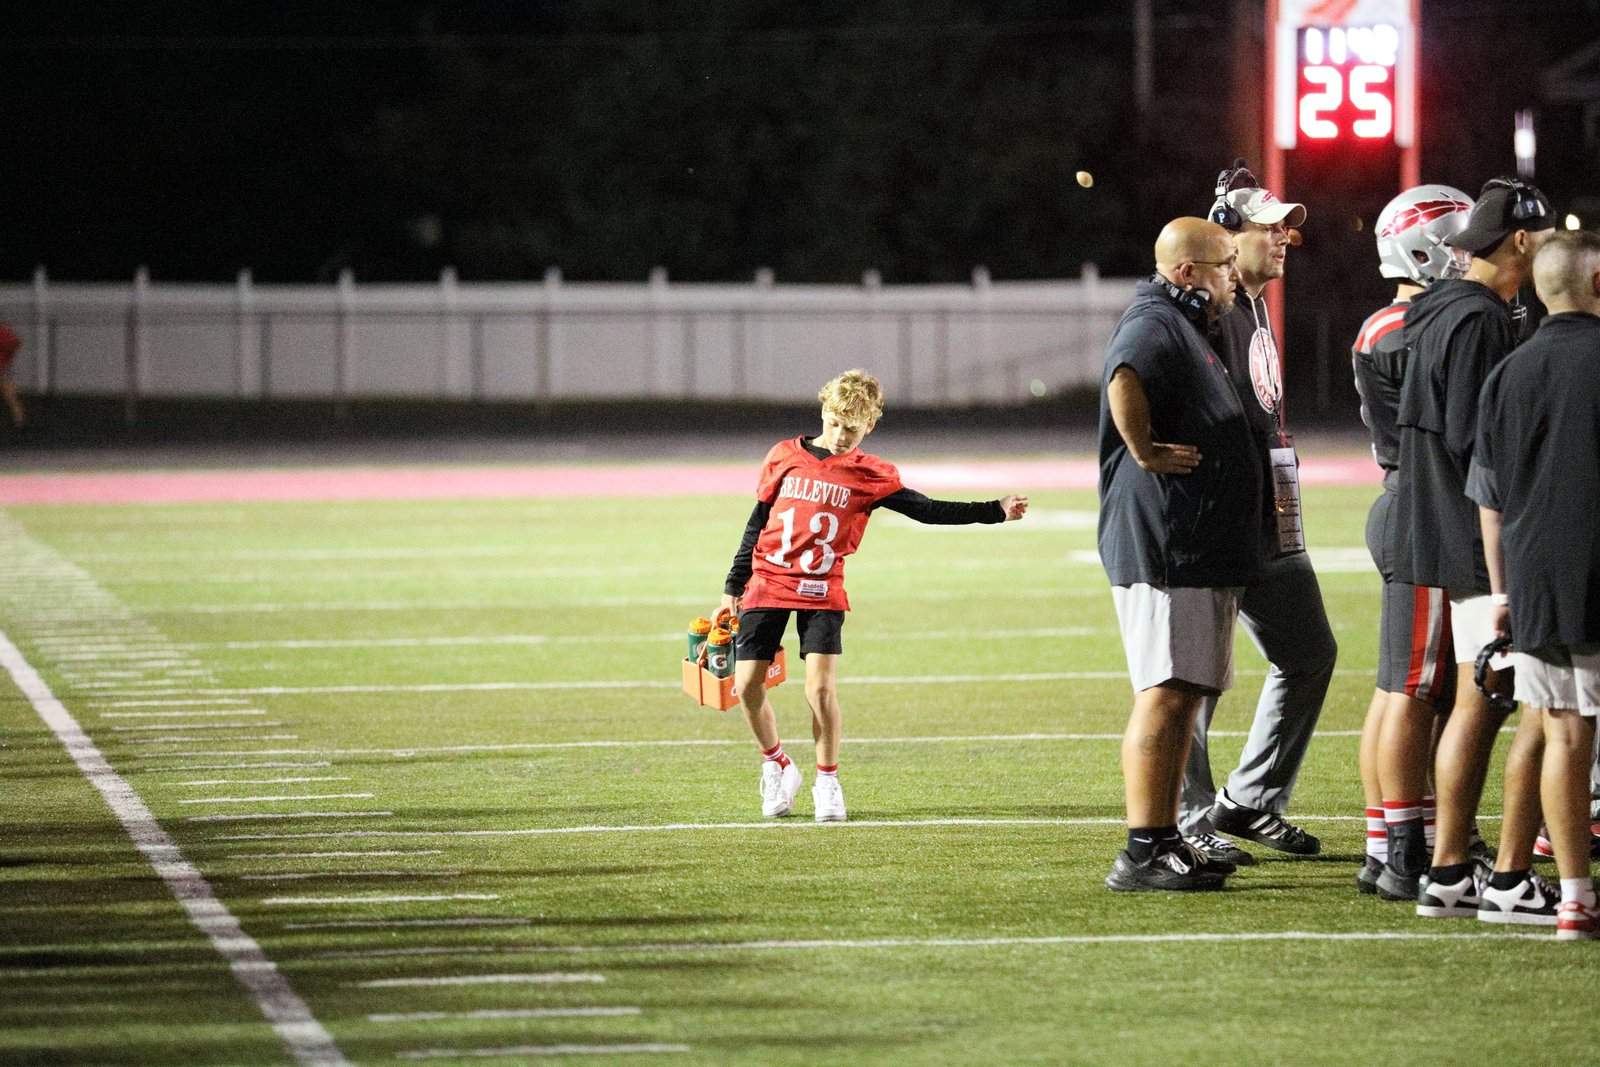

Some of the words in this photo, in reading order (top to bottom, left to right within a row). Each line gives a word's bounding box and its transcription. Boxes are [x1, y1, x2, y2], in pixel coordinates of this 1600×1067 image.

[1300, 66, 1392, 138] 25
[779, 476, 851, 509] BELLEVUE
[765, 507, 839, 575] 13
[711, 653, 728, 670] G
